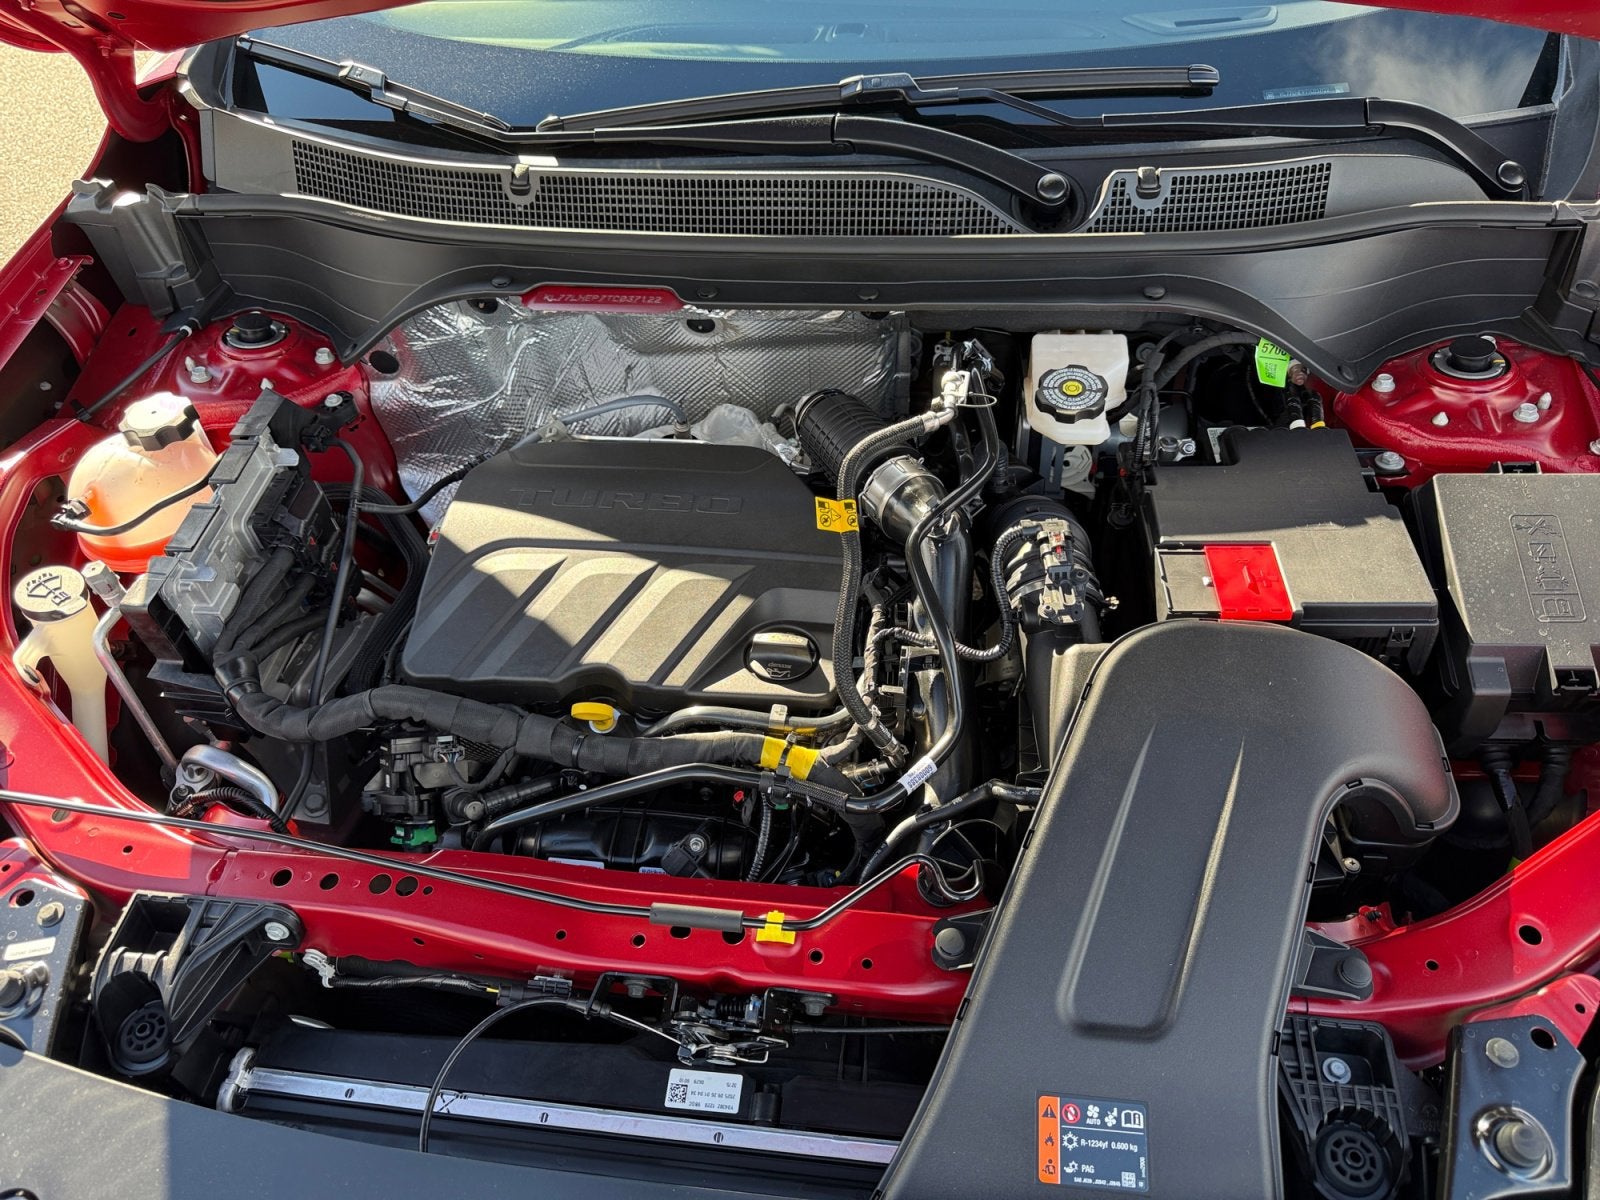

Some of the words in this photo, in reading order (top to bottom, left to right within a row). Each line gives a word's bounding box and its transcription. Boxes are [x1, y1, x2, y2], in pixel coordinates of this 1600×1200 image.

[509, 487, 744, 514] TURBO
[1080, 1138, 1109, 1149] R-1234yf
[1111, 1140, 1129, 1150] 0.600
[1129, 1142, 1138, 1152] kg
[1081, 1164, 1095, 1173] PAG
